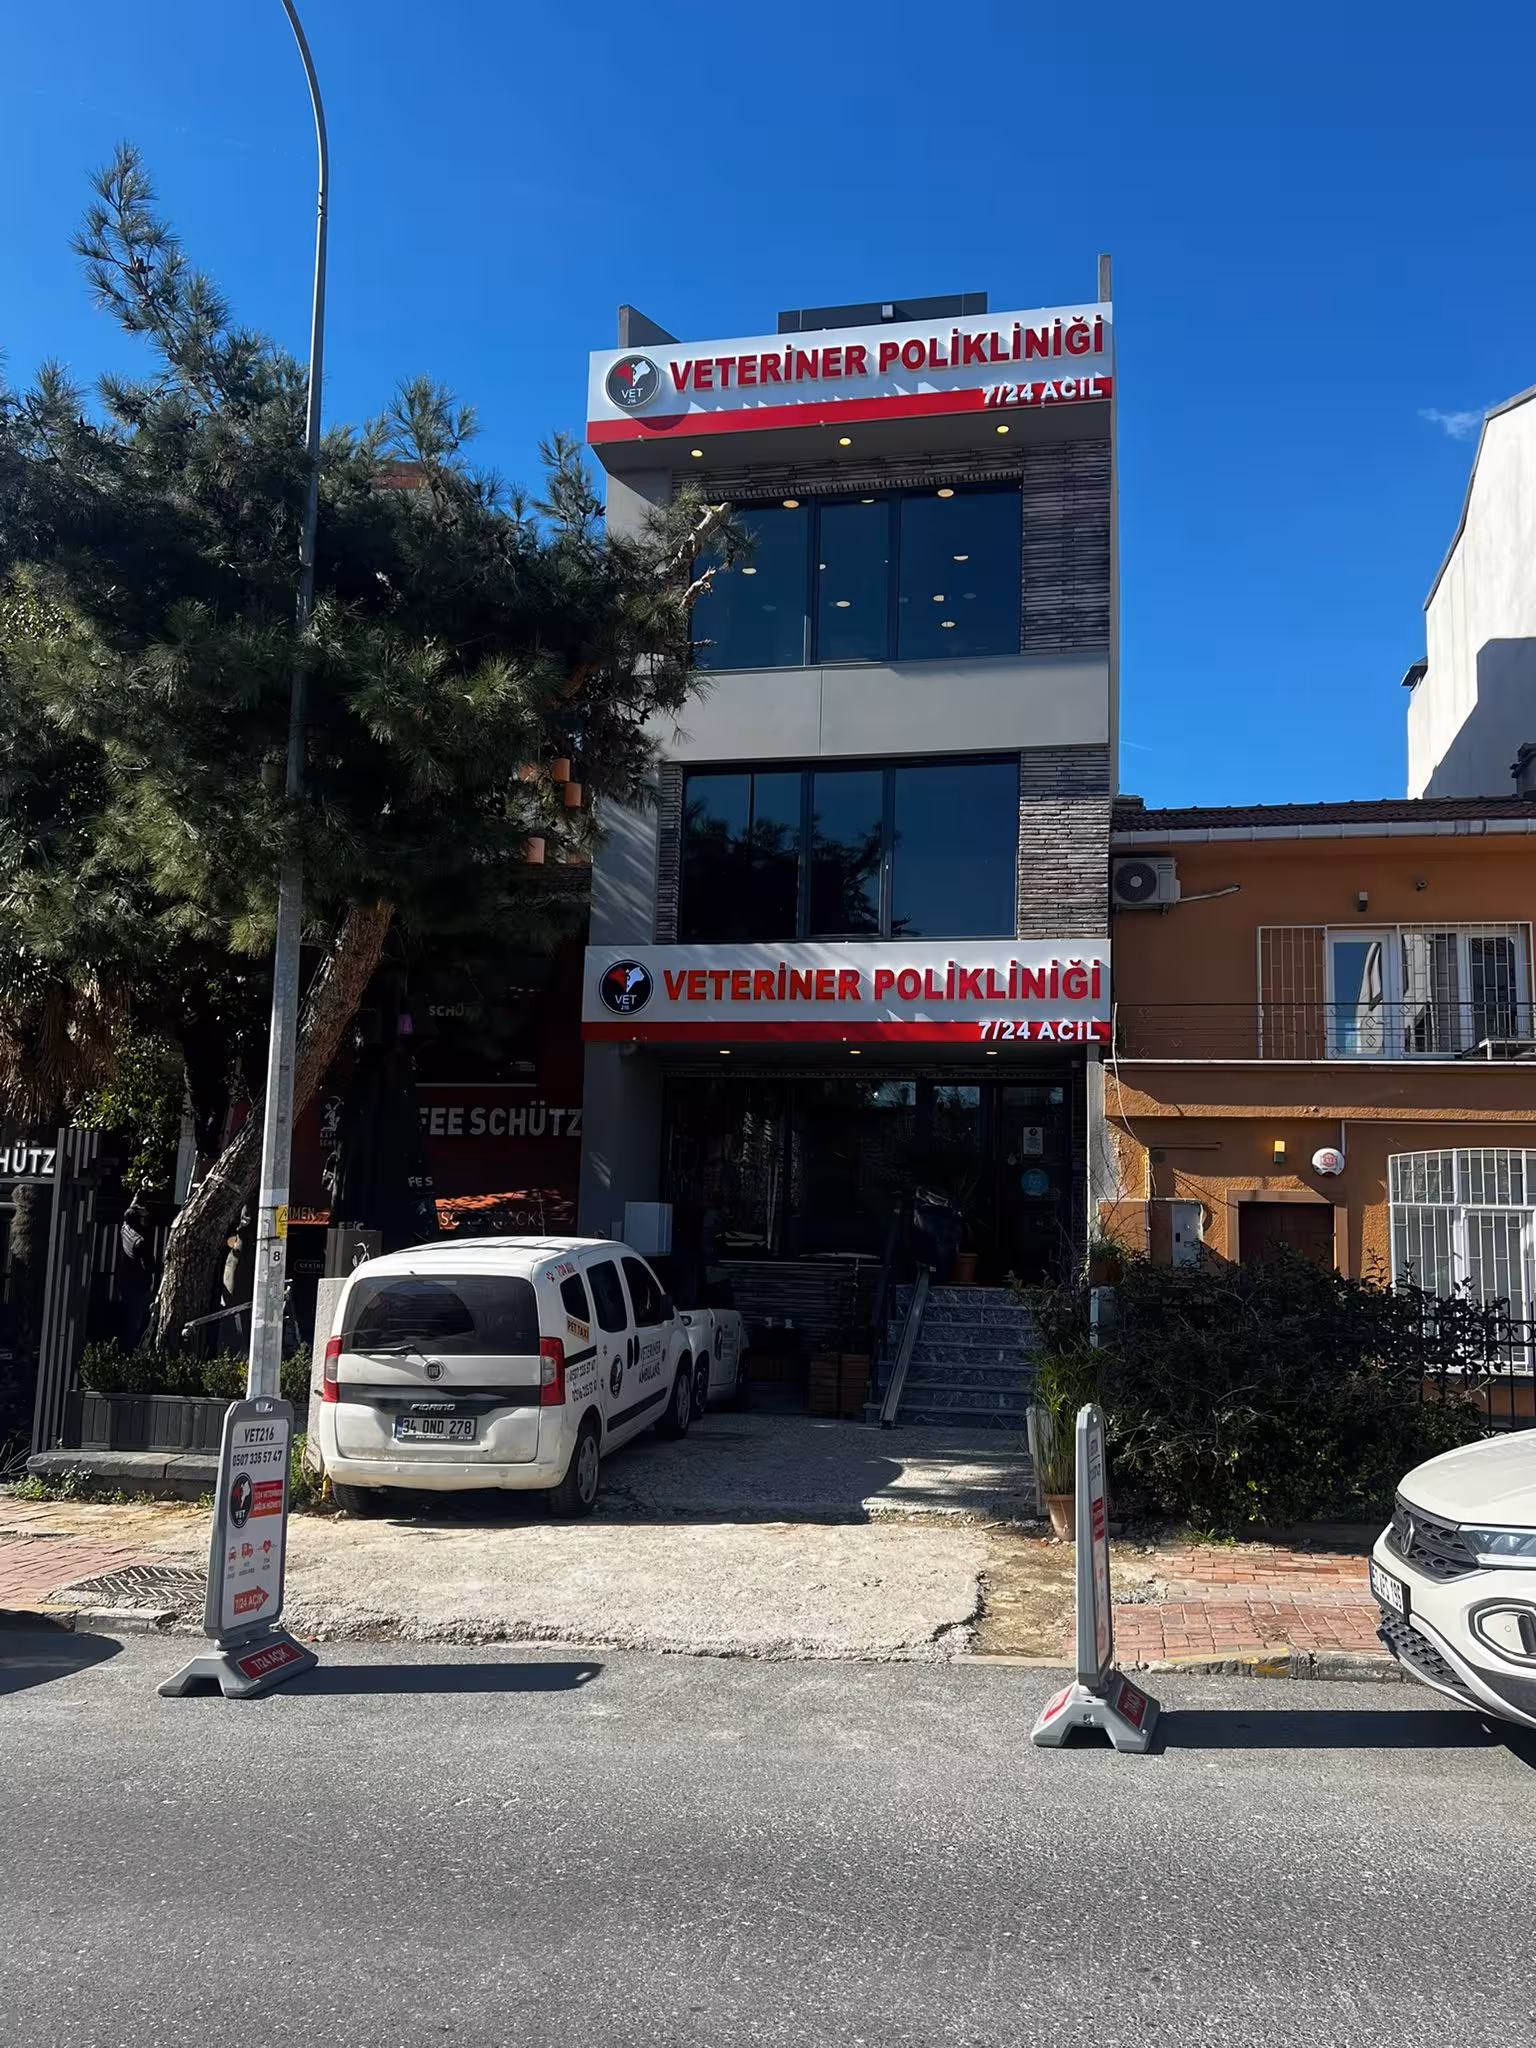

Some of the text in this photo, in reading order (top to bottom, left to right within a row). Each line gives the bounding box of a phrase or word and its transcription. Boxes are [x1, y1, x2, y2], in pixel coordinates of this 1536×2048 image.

[670, 315, 1101, 392] VETERİNER POLİKLİNİĞİ
[621, 388, 643, 398] VET
[982, 382, 1032, 406] 7/24
[664, 960, 1098, 1001] VETERİNER POLİKLİNİĞİ
[614, 994, 637, 1004] VET
[978, 1020, 1031, 1040] 7/24
[469, 1100, 583, 1137] SCHÜTZ
[273, 1251, 281, 1262] 8
[244, 1427, 274, 1443] VET216
[403, 1419, 416, 1434] 34
[449, 1420, 472, 1435] 278
[232, 1449, 283, 1467] 0507 335 57 47
